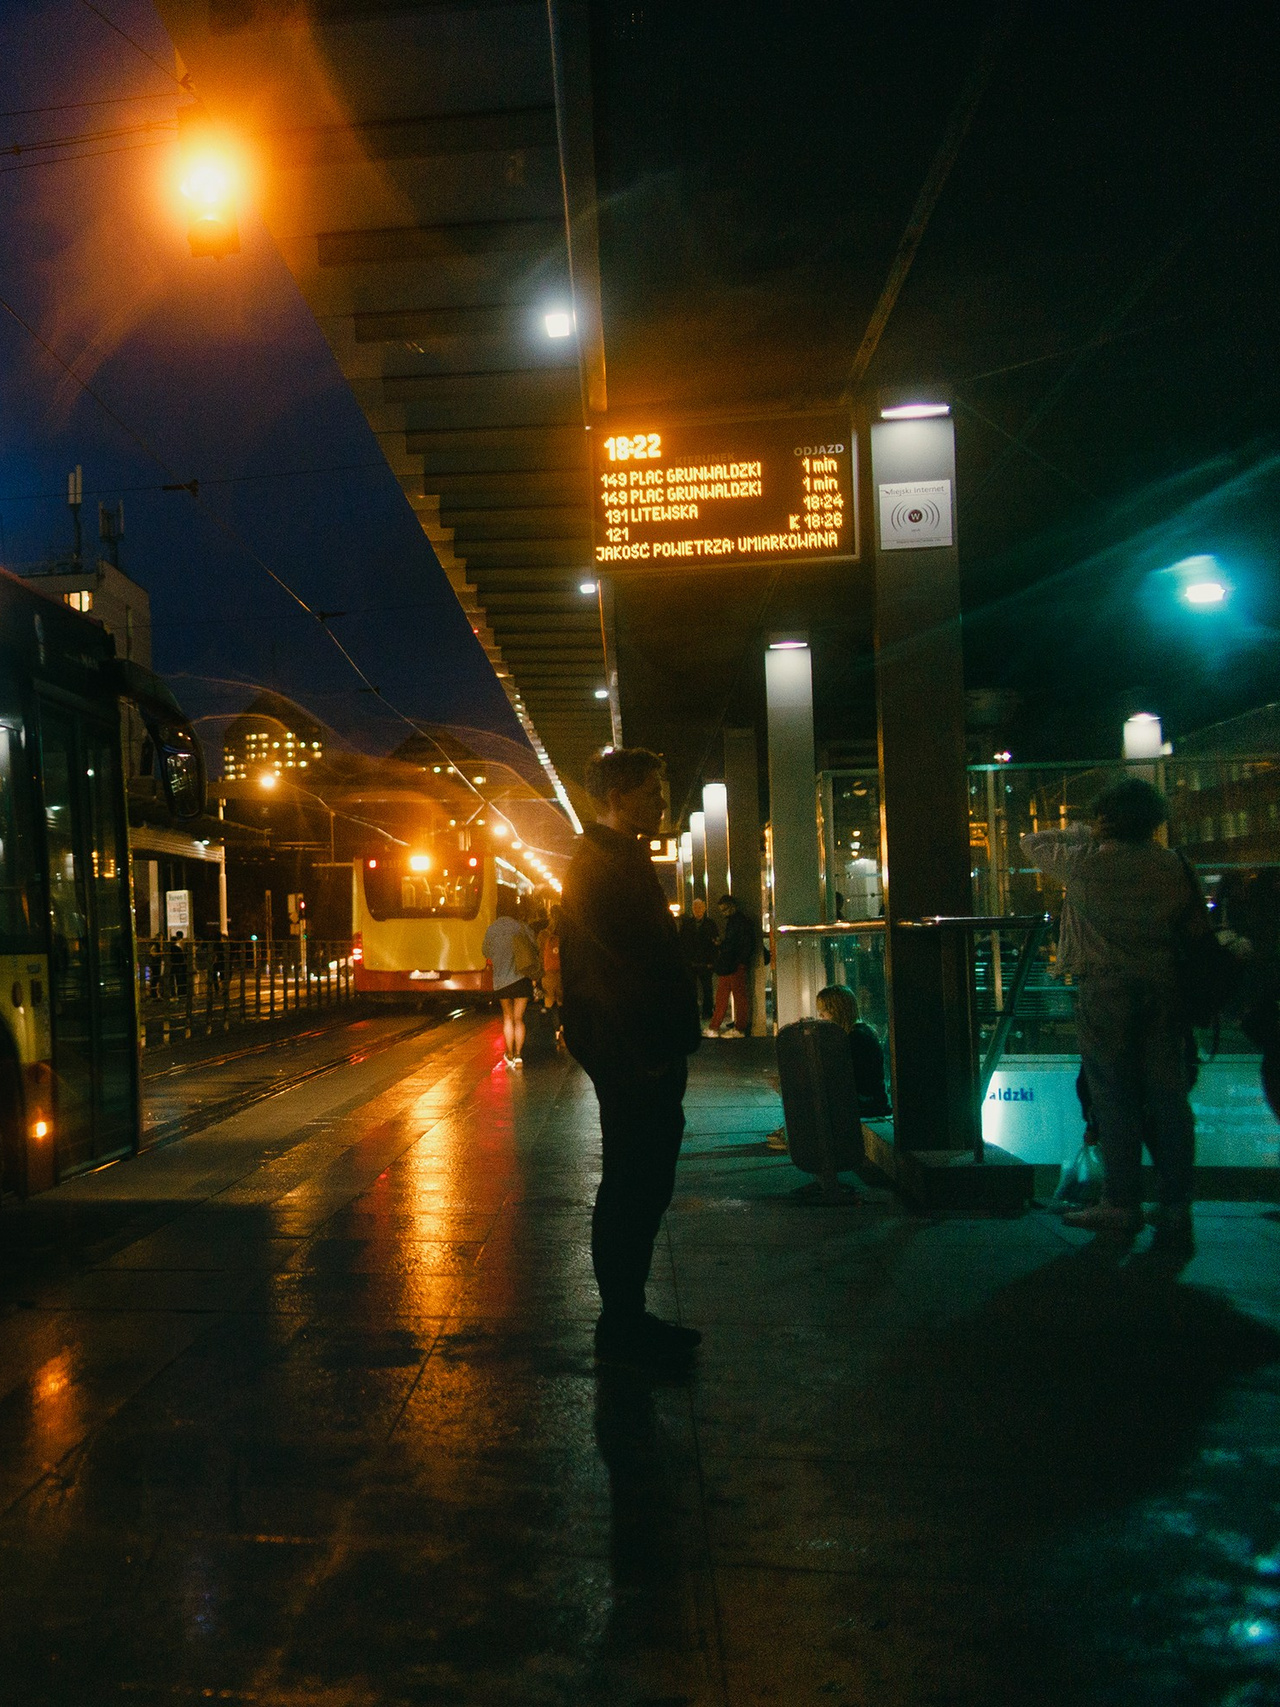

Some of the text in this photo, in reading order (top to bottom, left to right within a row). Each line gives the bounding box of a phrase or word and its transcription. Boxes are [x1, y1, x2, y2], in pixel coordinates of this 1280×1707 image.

[603, 433, 662, 461] 18:22
[794, 444, 845, 456] ODJAZD
[601, 455, 838, 488] 149 PLAC GRUNWALDZKI 1 min
[601, 474, 838, 507] 149 PLAC GRUNWALDZKI 1 min
[914, 486, 945, 494] Internet
[631, 504, 699, 523] LITEWSKA
[803, 492, 844, 511] 18:24
[606, 511, 843, 543] 121 K 18:26
[596, 530, 838, 561] JAKOŚĆ POWIETRZA: UMIARKOWANA
